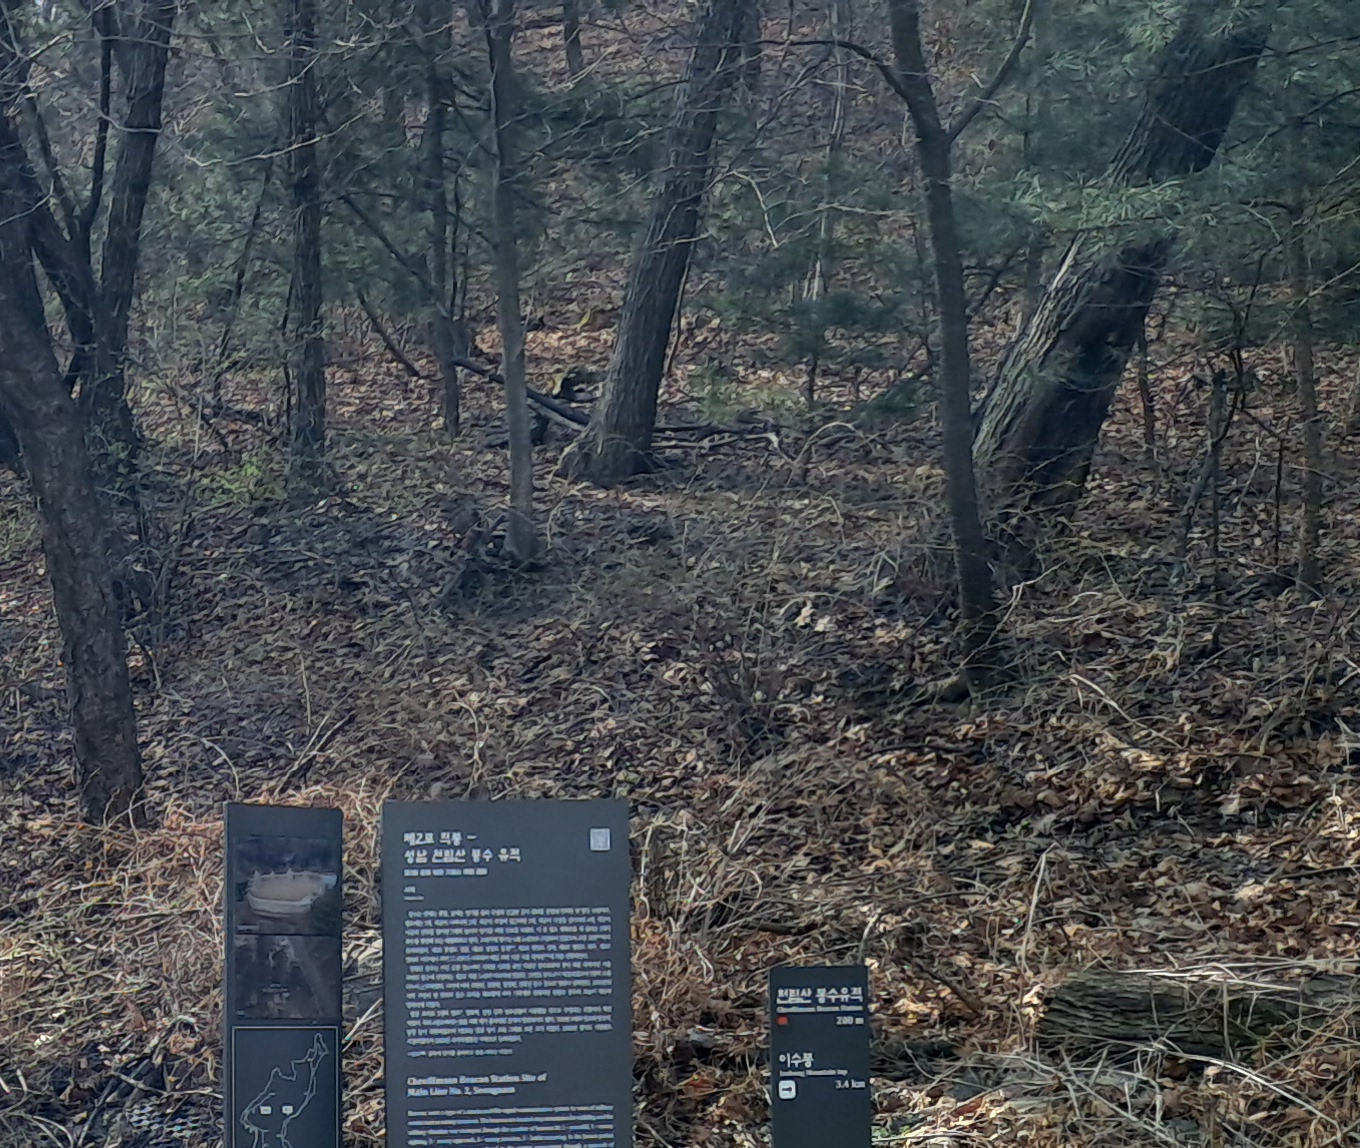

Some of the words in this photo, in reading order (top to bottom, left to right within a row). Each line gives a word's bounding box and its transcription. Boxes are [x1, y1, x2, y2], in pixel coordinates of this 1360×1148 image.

[404, 848, 428, 864] 성남
[471, 848, 494, 863] 봉수
[498, 847, 521, 863] 유적
[777, 988, 812, 1004] 천림산
[815, 987, 863, 1003] 봉수유적
[836, 1016, 854, 1026] 200
[779, 1052, 814, 1068] 이수봉
